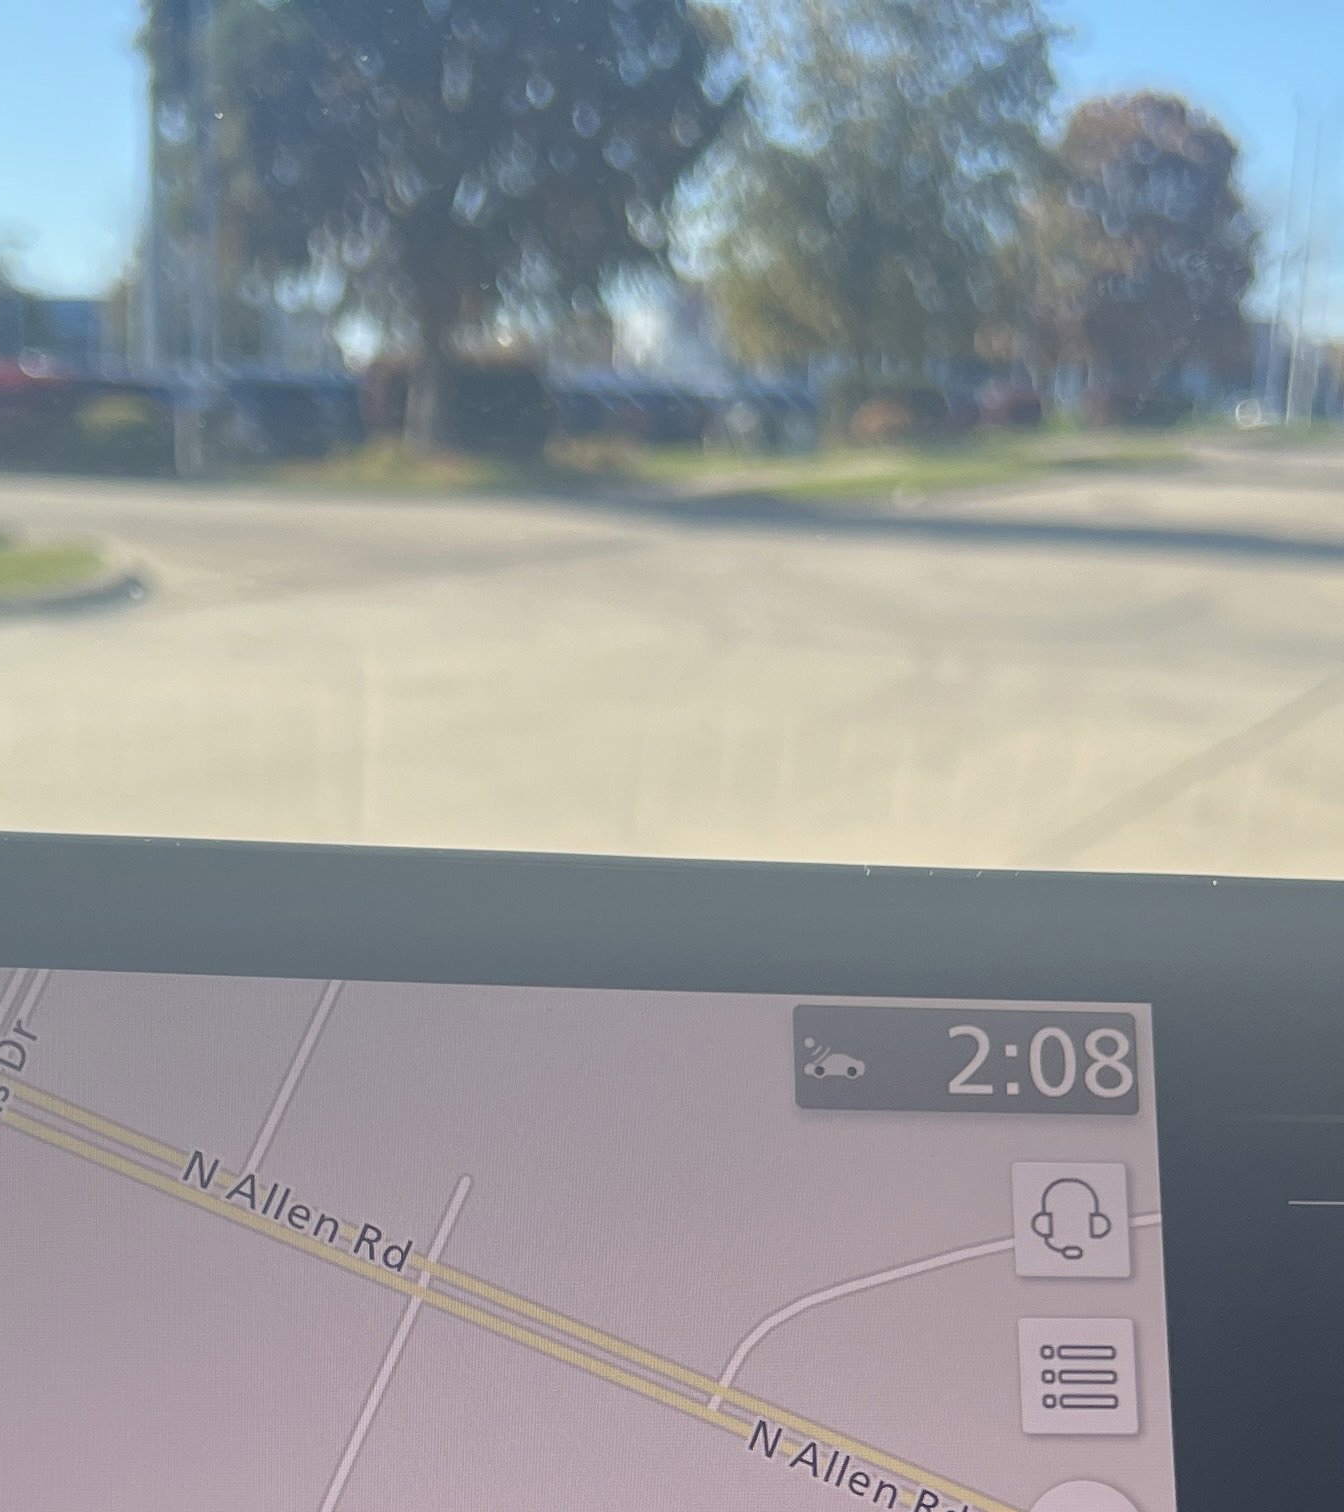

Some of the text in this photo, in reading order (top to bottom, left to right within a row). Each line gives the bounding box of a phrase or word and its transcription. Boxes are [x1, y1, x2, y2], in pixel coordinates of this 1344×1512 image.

[946, 1023, 1135, 1099] 2:08
[181, 1150, 413, 1273] N Allen Rd
[747, 1418, 784, 1459] N
[789, 1441, 899, 1510] Allen
